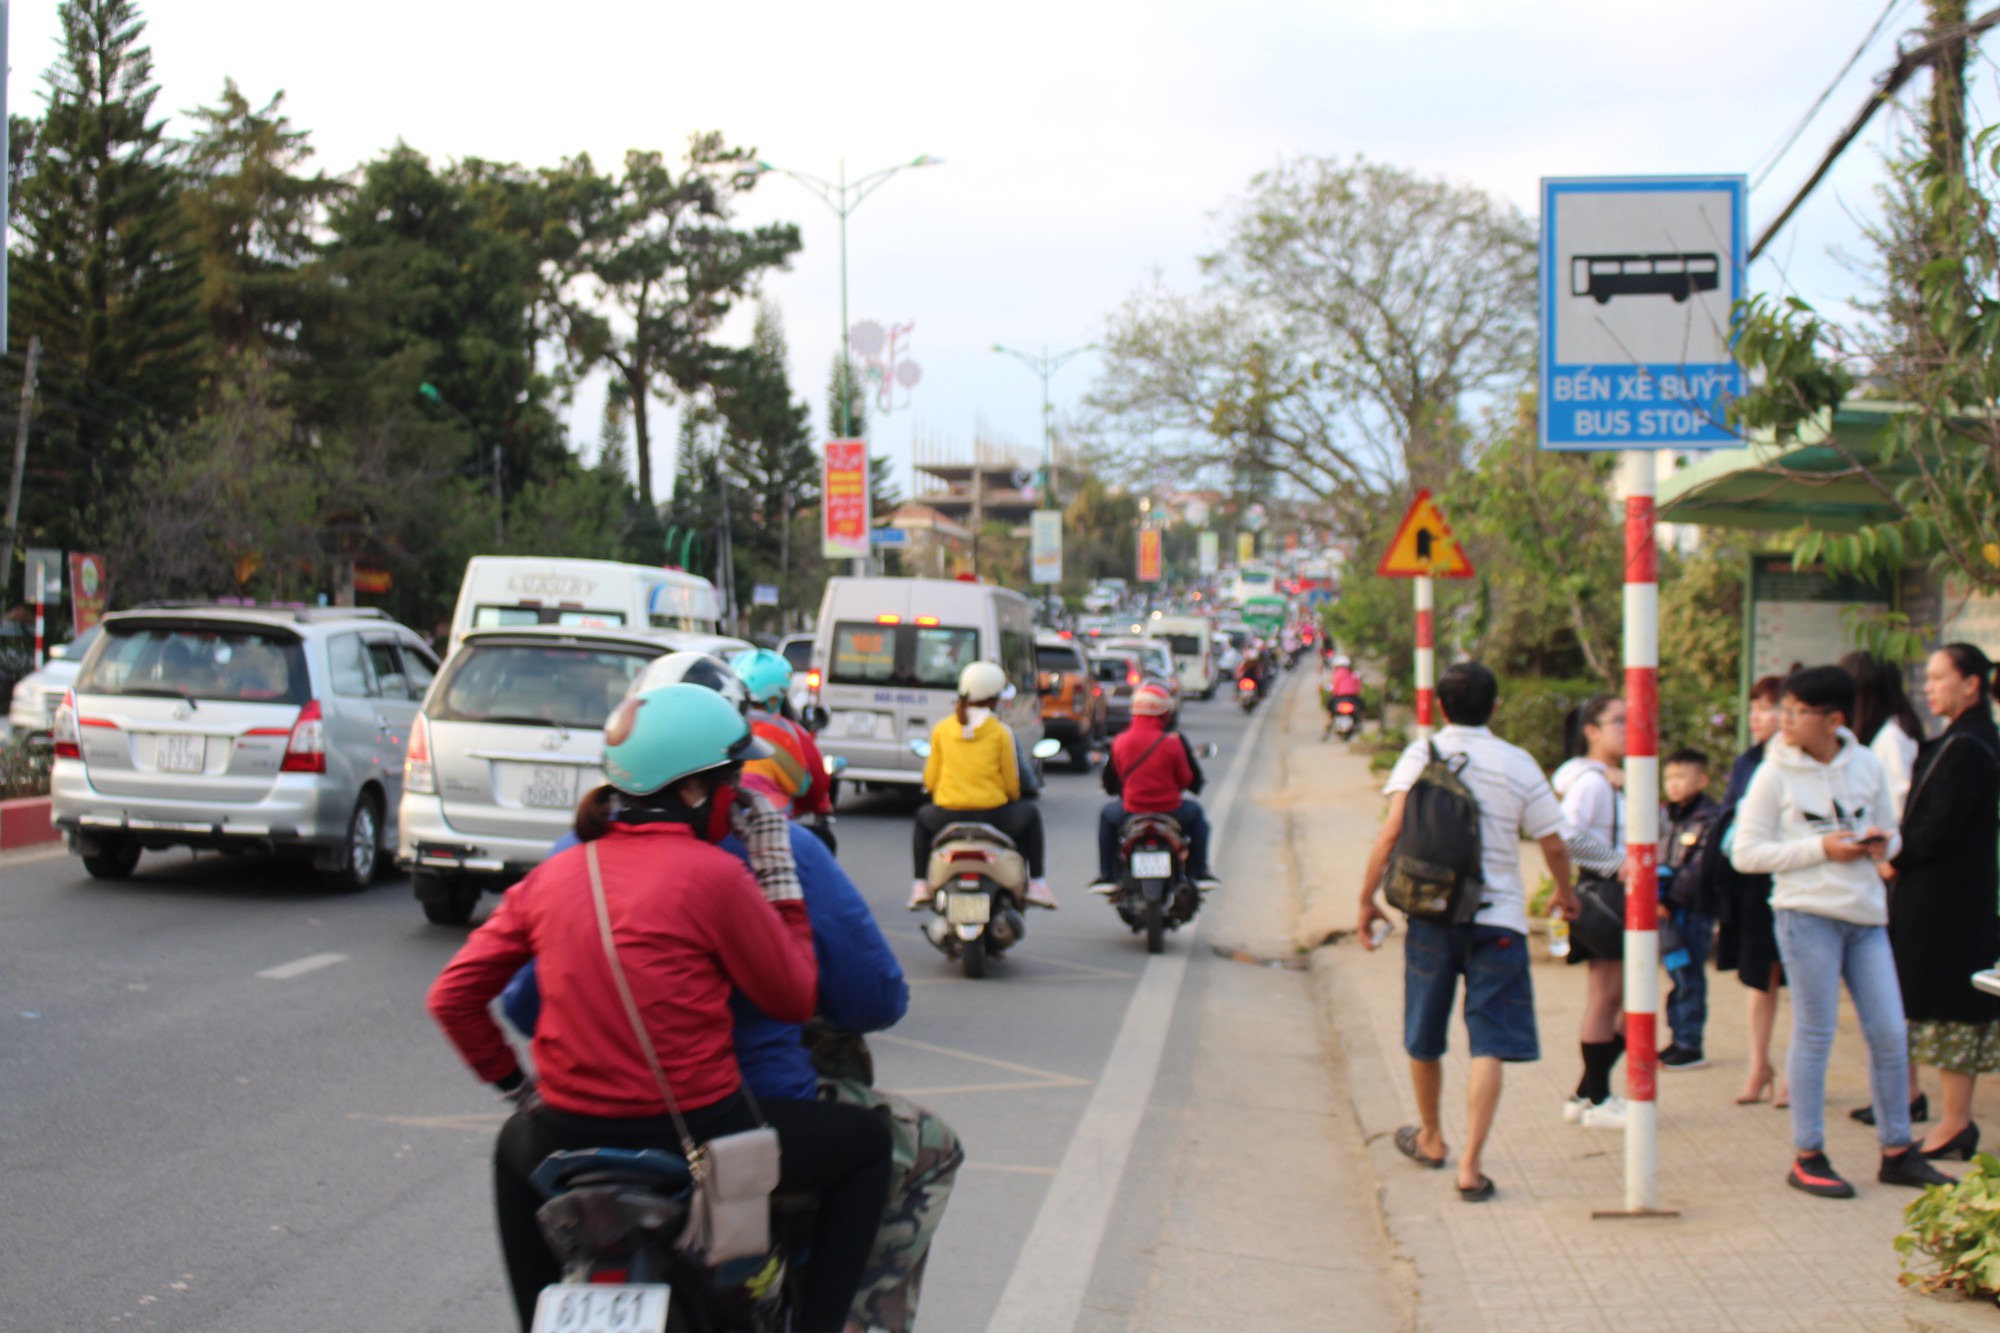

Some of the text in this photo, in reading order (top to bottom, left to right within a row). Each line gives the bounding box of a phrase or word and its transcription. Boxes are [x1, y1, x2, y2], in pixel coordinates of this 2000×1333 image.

[1554, 366, 1611, 401] BẾN
[1660, 369, 1733, 401] BUÝT
[1574, 409, 1711, 436] BUS STOP
